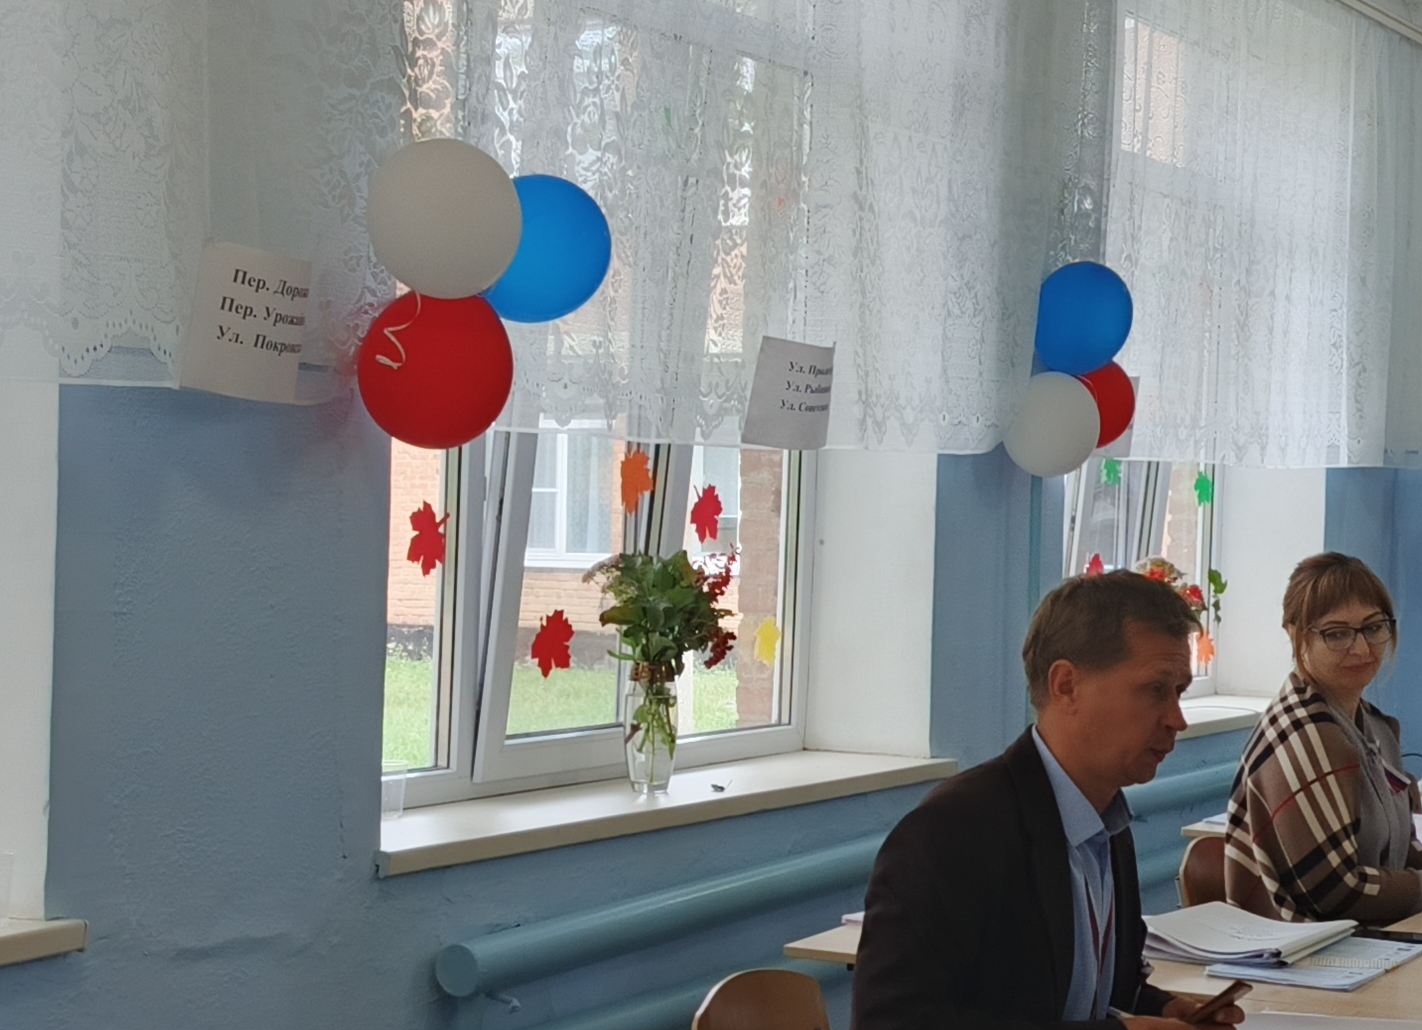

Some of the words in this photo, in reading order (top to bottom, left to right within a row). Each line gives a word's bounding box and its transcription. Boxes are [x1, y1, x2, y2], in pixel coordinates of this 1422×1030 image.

[232, 268, 270, 293] Пер.
[219, 296, 258, 320] Пер.
[216, 325, 244, 345] Ул.
